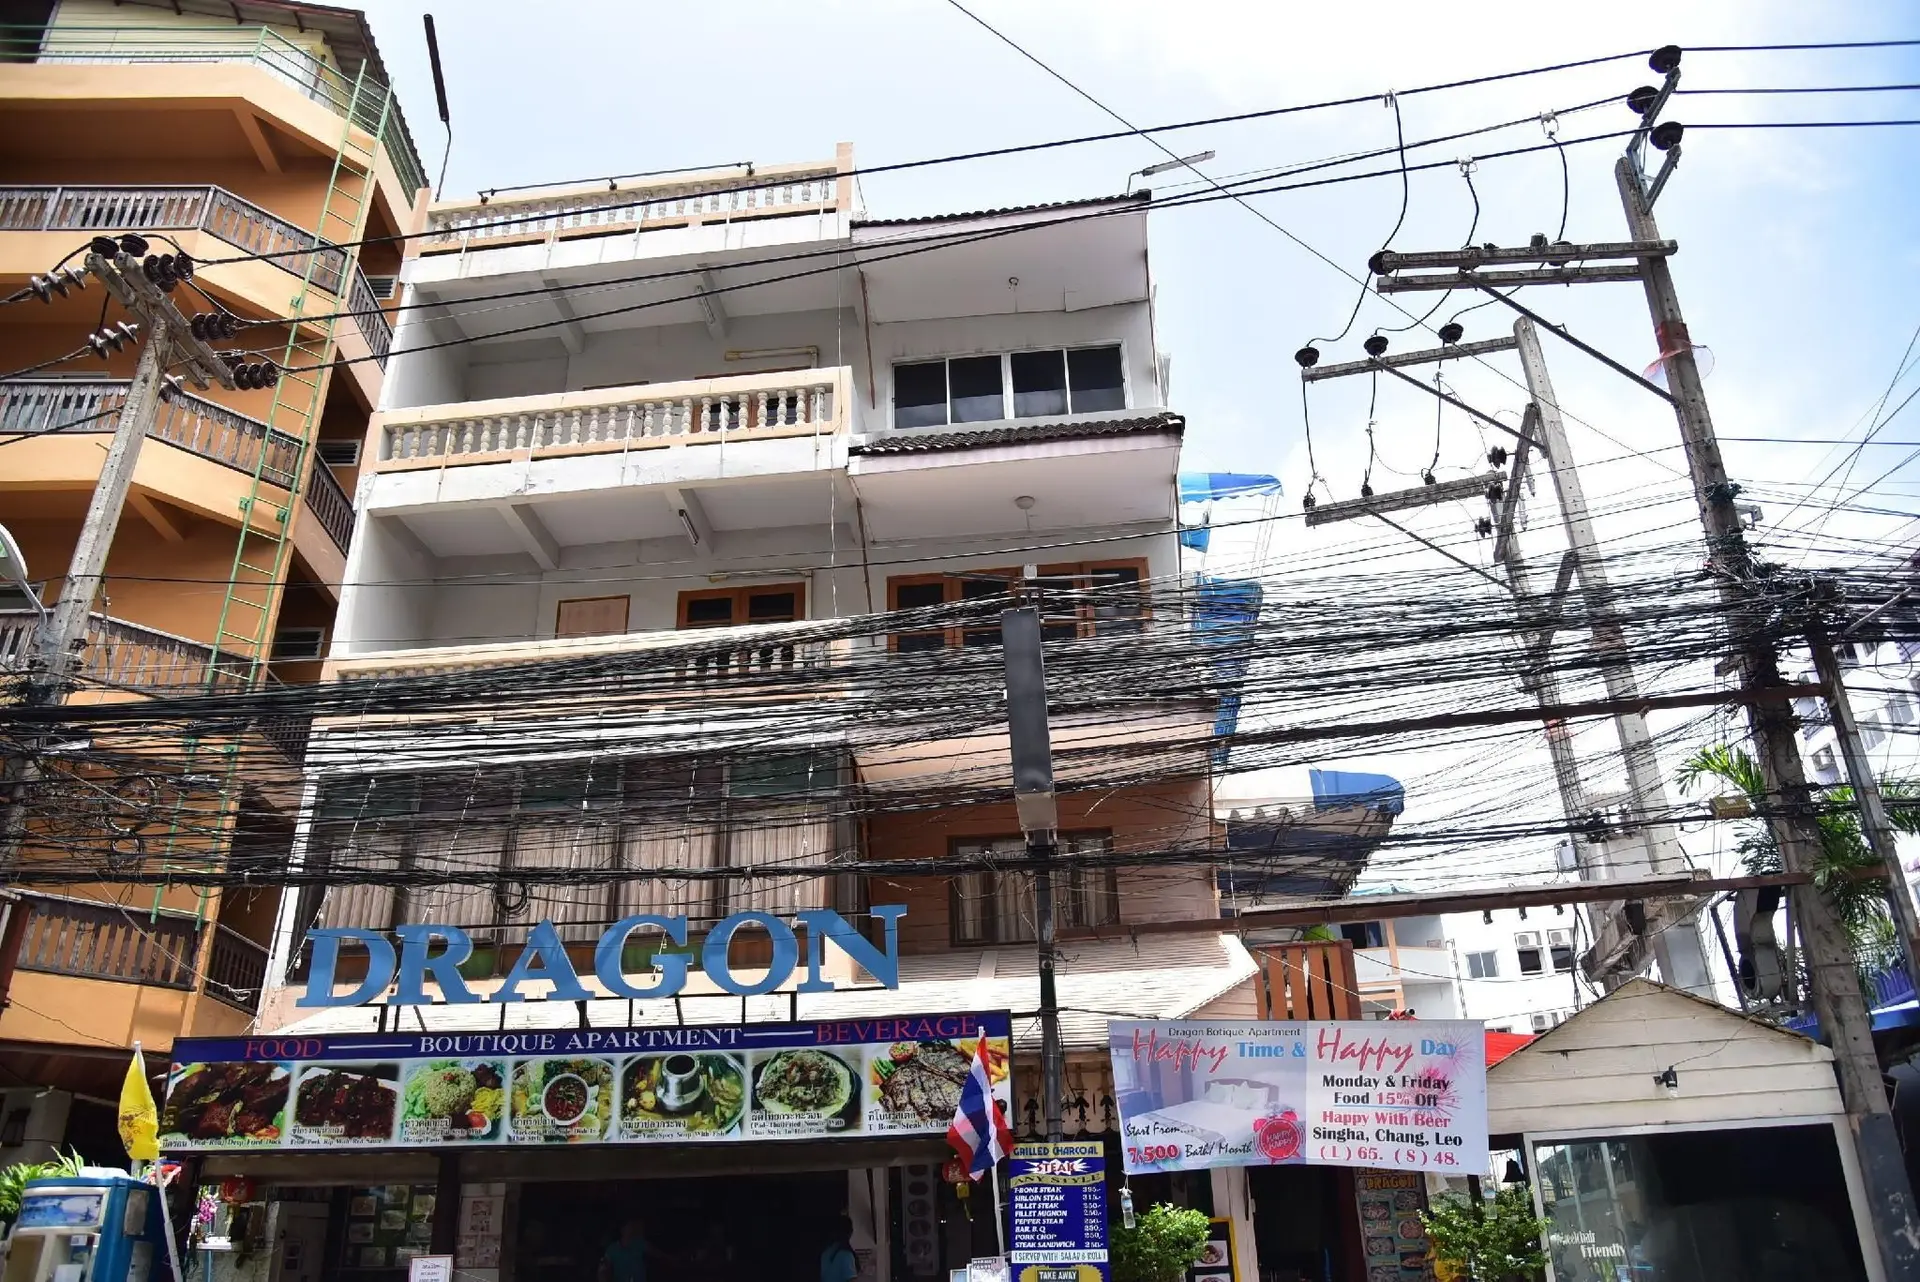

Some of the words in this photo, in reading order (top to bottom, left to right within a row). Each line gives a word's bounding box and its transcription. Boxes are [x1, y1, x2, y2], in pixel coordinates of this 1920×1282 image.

[296, 904, 908, 1007] DRAGON
[816, 1015, 977, 1043] BEVERAGE
[1168, 1028, 1204, 1037] Dragon
[1206, 1028, 1244, 1037] Botique
[1248, 1028, 1301, 1037] Apartment
[419, 1034, 556, 1053] BOUTIQUE
[565, 1027, 742, 1050] APARTMENT
[244, 1038, 323, 1059] FOOD
[1132, 1028, 1228, 1073] Happy
[1236, 1042, 1285, 1058] Time
[1292, 1041, 1306, 1058] &
[1317, 1028, 1414, 1073] Happy
[1421, 1039, 1457, 1057] Day
[1322, 1075, 1380, 1089] Monday
[1386, 1075, 1396, 1088] &
[1402, 1075, 1450, 1090] Friday
[1334, 1092, 1370, 1104] Food
[1377, 1093, 1410, 1105] 15%
[1415, 1093, 1439, 1106] Off
[901, 1121, 922, 1129] Steak
[1322, 1111, 1369, 1125] Happy
[1375, 1112, 1409, 1126] With
[1414, 1113, 1452, 1128] Beer
[1126, 1121, 1150, 1137] Start
[1313, 1127, 1370, 1142] Singha,
[1375, 1129, 1430, 1145] Chang,
[1435, 1132, 1463, 1146] Leo
[1014, 1146, 1049, 1155] GRILLED
[1053, 1145, 1098, 1154] CHARCOAL
[1127, 1144, 1180, 1165] 7,500
[1218, 1141, 1253, 1154] Month
[1357, 1147, 1384, 1160] 65.
[1433, 1152, 1460, 1165] 48.
[1036, 1163, 1076, 1172] STEAK
[1580, 1243, 1625, 1258] Friendly
[1039, 1271, 1056, 1280] TAKE
[1058, 1271, 1077, 1279] AWAY
